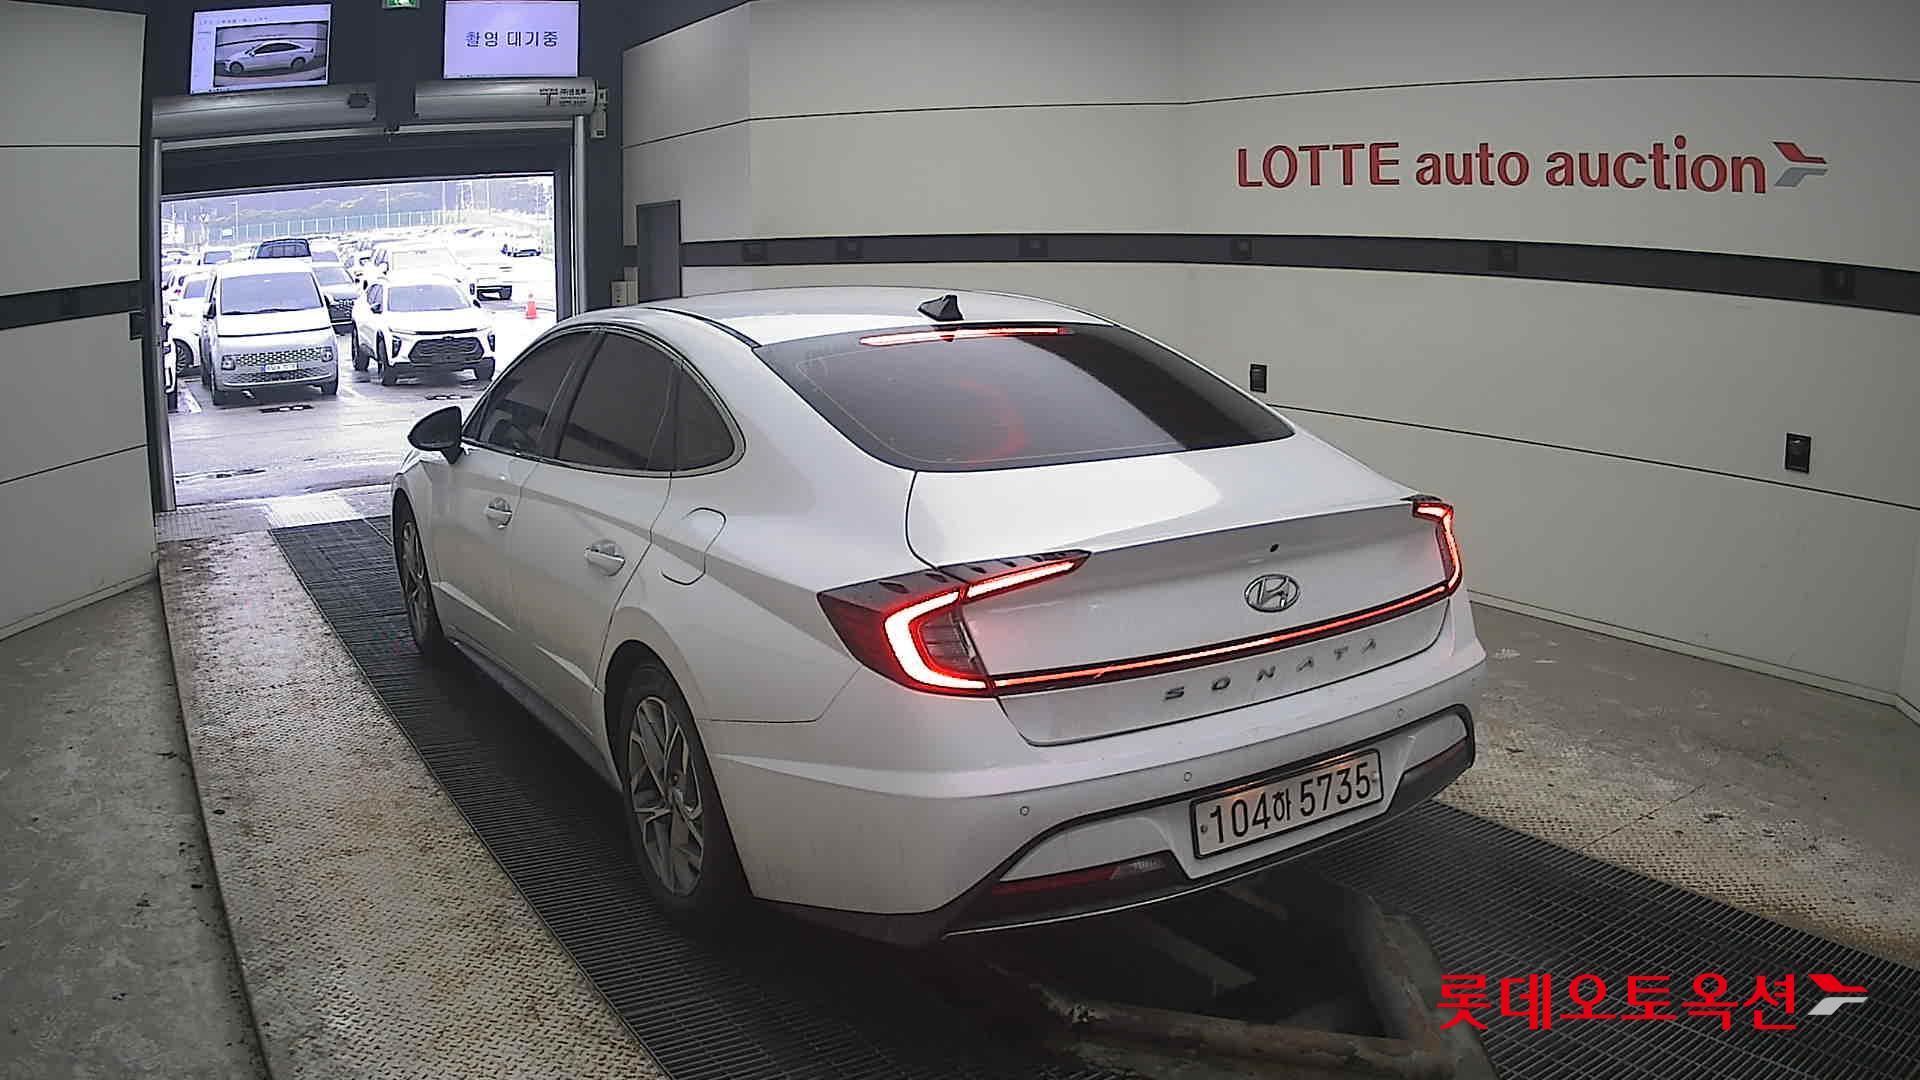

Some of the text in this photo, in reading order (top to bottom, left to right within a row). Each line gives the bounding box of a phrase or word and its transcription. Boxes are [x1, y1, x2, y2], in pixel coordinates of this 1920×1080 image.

[507, 31, 558, 47] 대기중
[1237, 134, 1766, 193] LOTTE auto auction
[1164, 638, 1376, 700] SONATA
[1299, 762, 1371, 816] 5735
